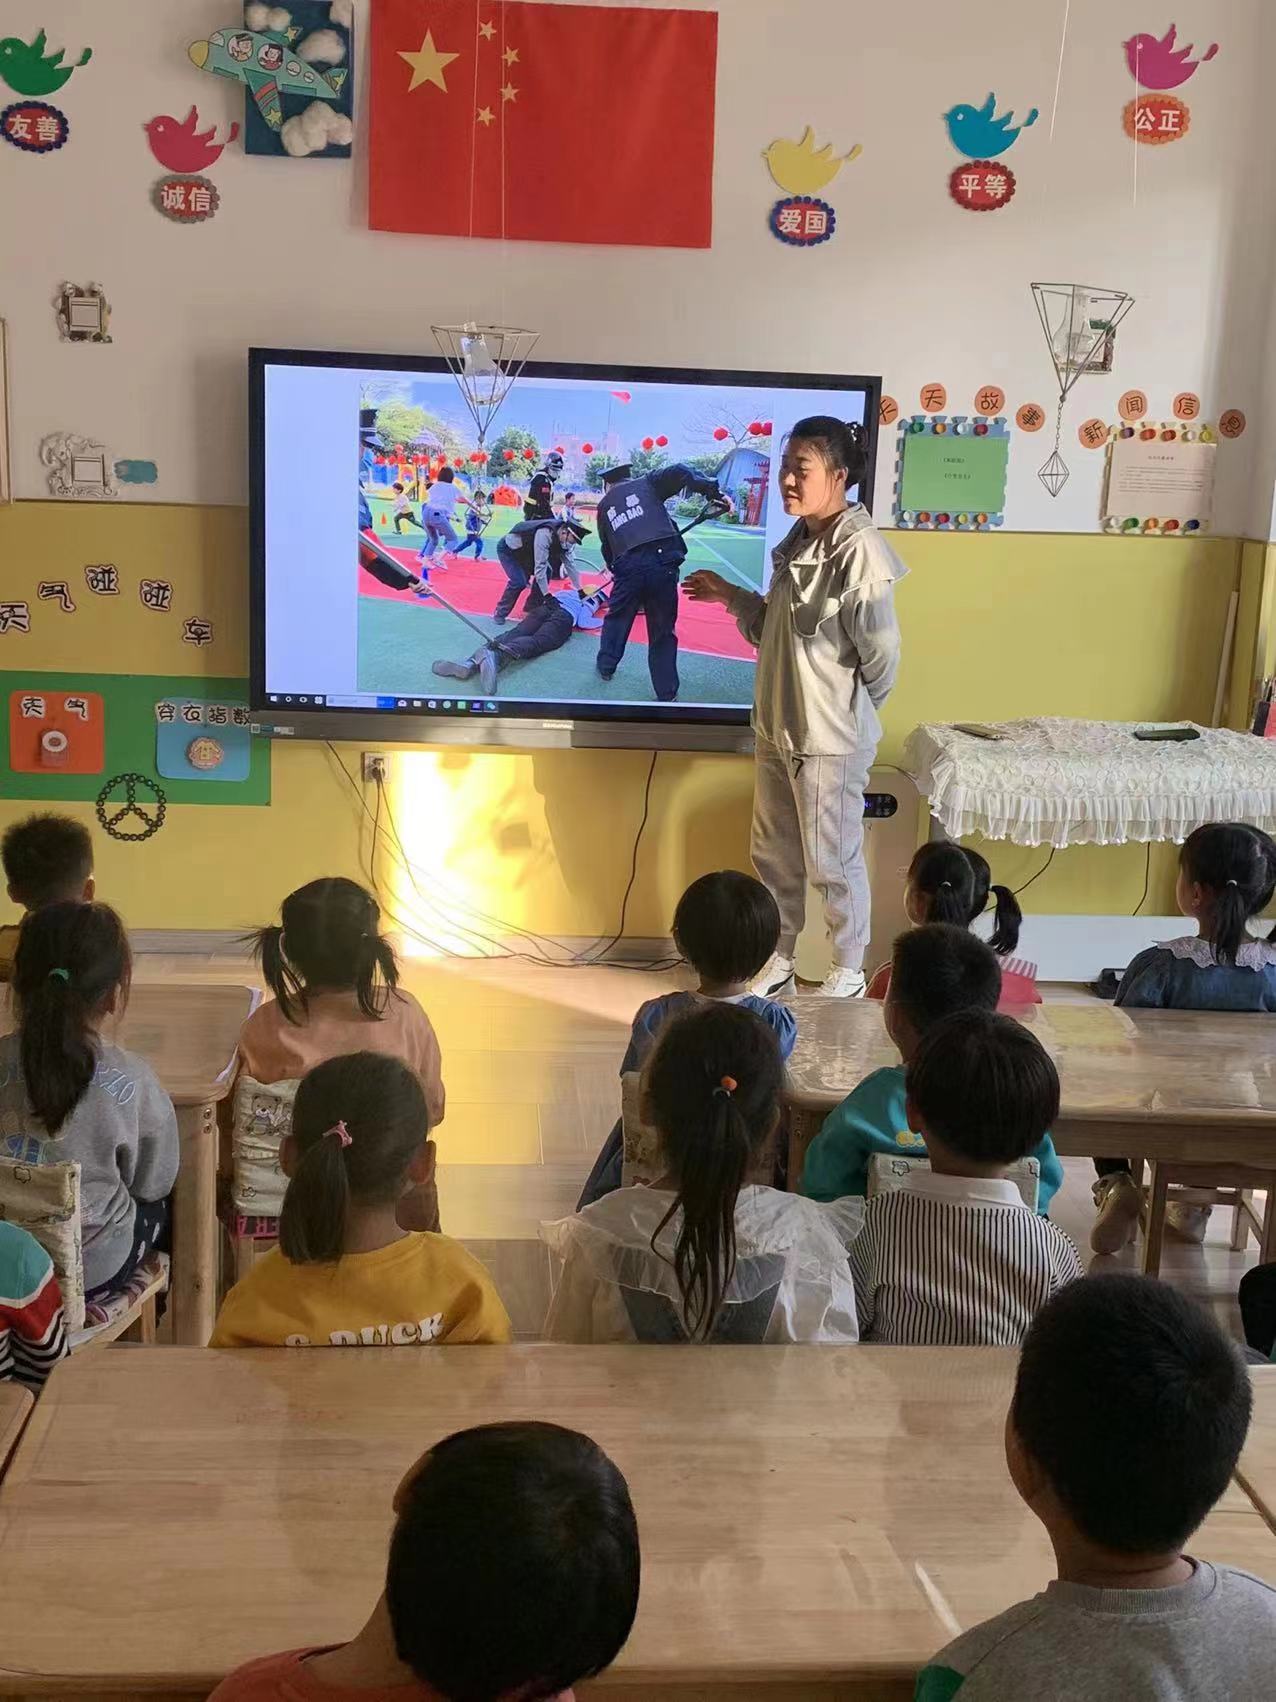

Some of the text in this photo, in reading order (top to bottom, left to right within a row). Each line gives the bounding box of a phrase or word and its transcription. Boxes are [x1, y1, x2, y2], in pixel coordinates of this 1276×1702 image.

[9, 114, 60, 142] 友善
[1134, 107, 1181, 133] 公正
[161, 185, 211, 211] 诚信
[958, 174, 1007, 199] 平等
[779, 208, 828, 235] 爱国
[1083, 395, 1242, 444] 新闻信息
[22, 698, 87, 719] 天气
[158, 703, 251, 726] 穿衣指数
